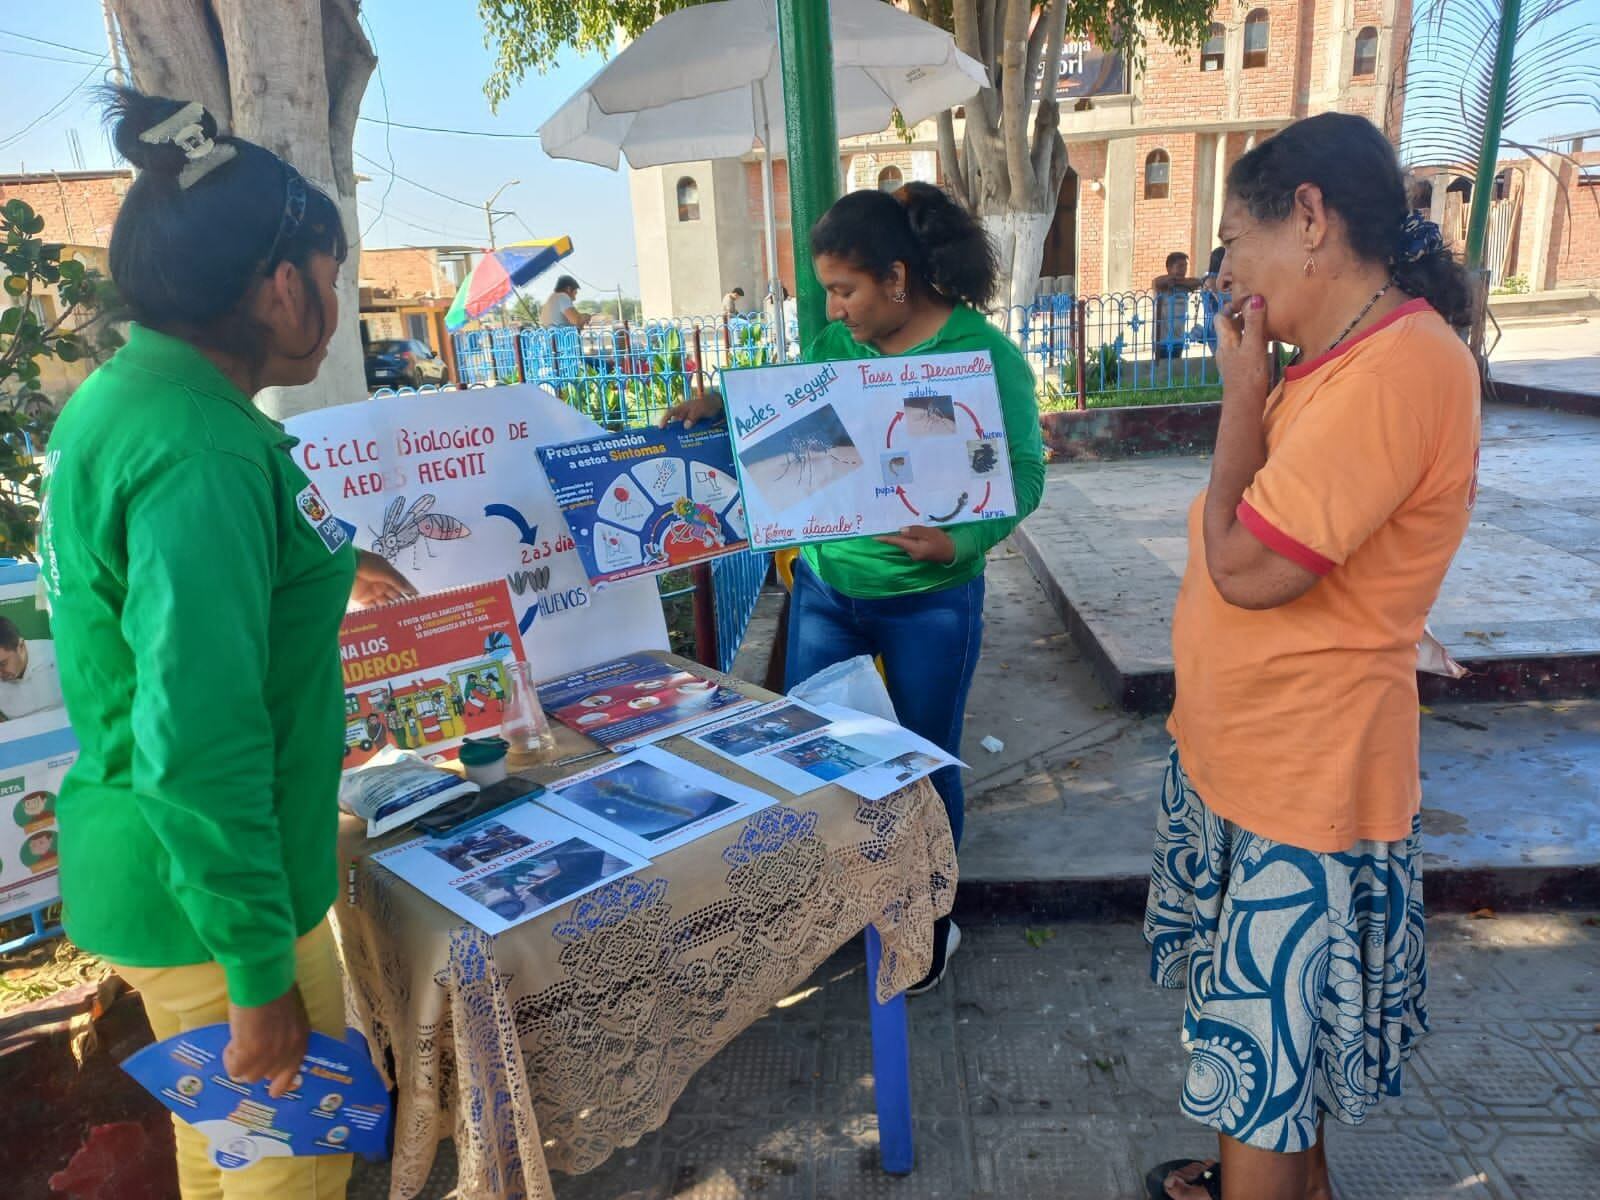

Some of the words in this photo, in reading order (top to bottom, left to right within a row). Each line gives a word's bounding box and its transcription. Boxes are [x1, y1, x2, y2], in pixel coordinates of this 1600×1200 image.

[857, 364, 893, 384] Fases
[901, 363, 917, 381] de
[921, 357, 992, 379] Desarrollo
[735, 403, 776, 437] Aedes
[785, 358, 837, 402] aegypti
[908, 385, 938, 398] adulto
[508, 421, 529, 440] DE
[546, 442, 592, 460] Presta
[592, 434, 646, 452] atención
[418, 452, 486, 484] AEGYTI
[569, 461, 577, 469] a
[578, 455, 608, 468] estos
[874, 485, 895, 497] pupa
[981, 508, 1005, 520] larva
[521, 550, 533, 564] 2
[542, 541, 552, 557] 3
[538, 587, 588, 617] HUEVOS
[361, 637, 390, 657] LOS
[0, 783, 22, 796] RTA
[448, 859, 503, 887] CONTROL
